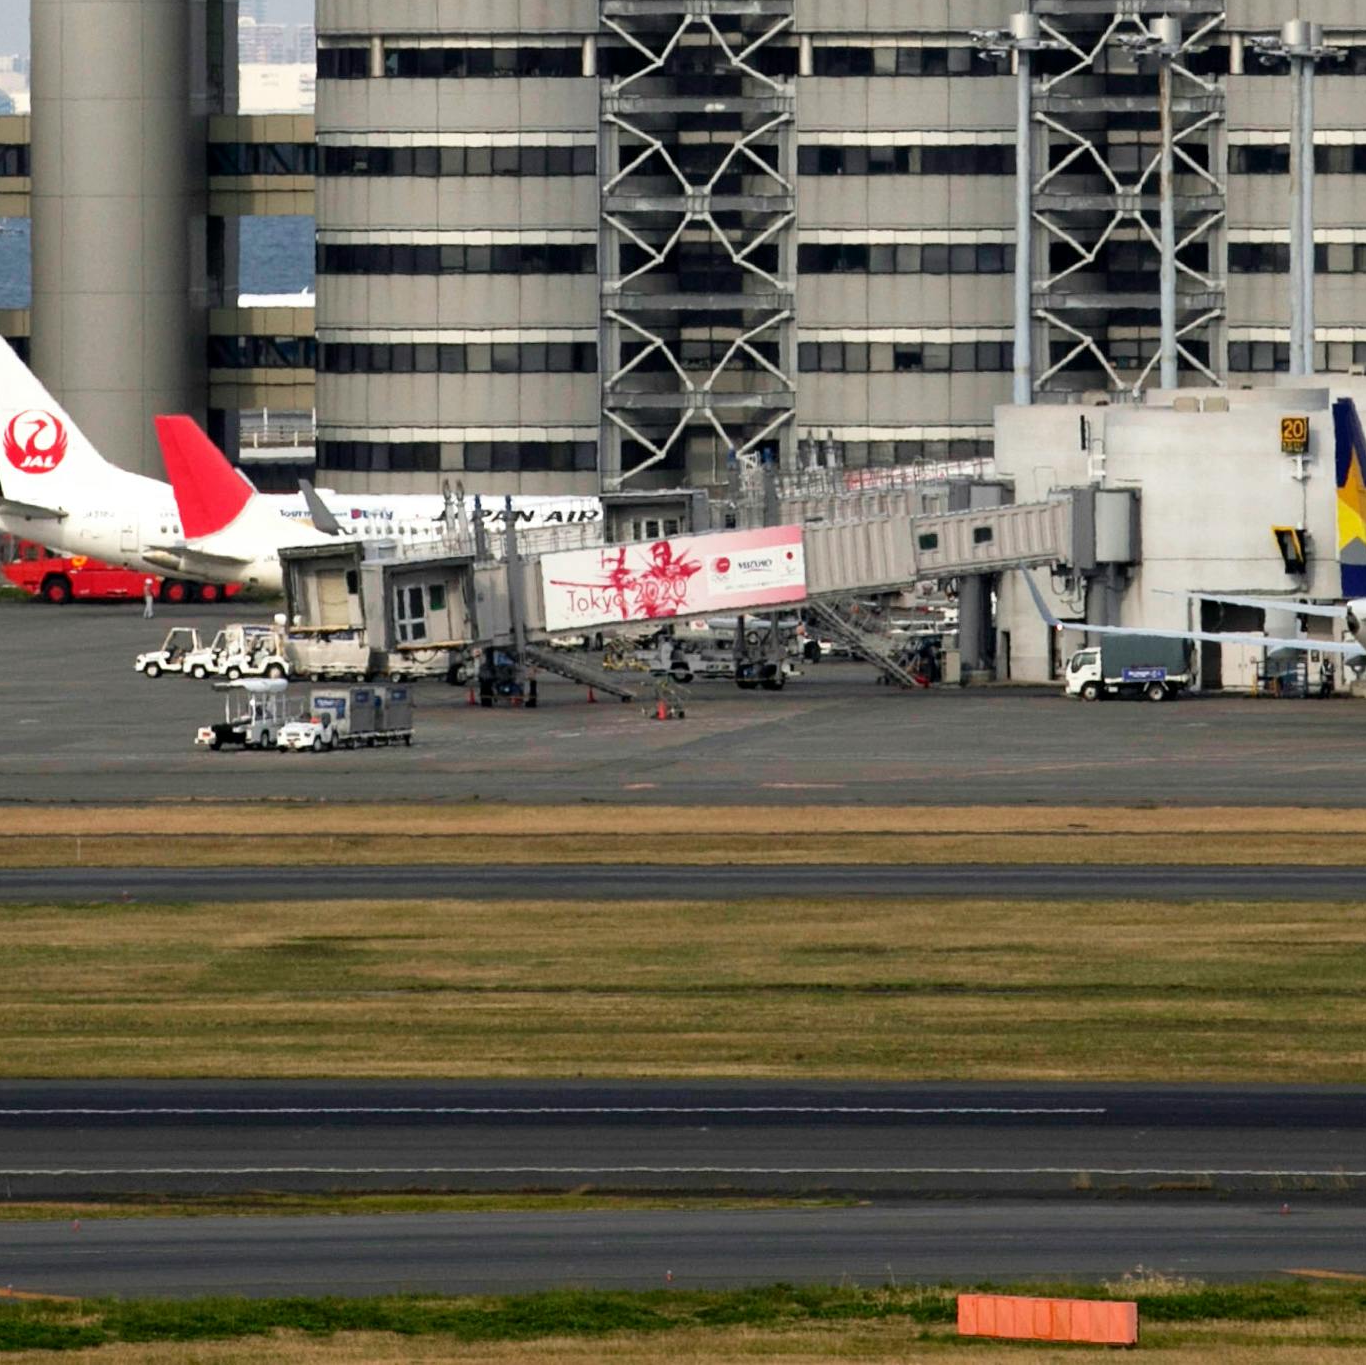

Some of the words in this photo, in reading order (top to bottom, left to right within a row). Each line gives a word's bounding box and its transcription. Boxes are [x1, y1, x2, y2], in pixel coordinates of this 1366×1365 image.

[1284, 419, 1304, 438] 20
[20, 455, 56, 468] JAL
[431, 509, 535, 523] JPAN
[544, 510, 600, 523] AIR
[566, 589, 623, 615] Tokyo
[633, 576, 688, 605] 2020
